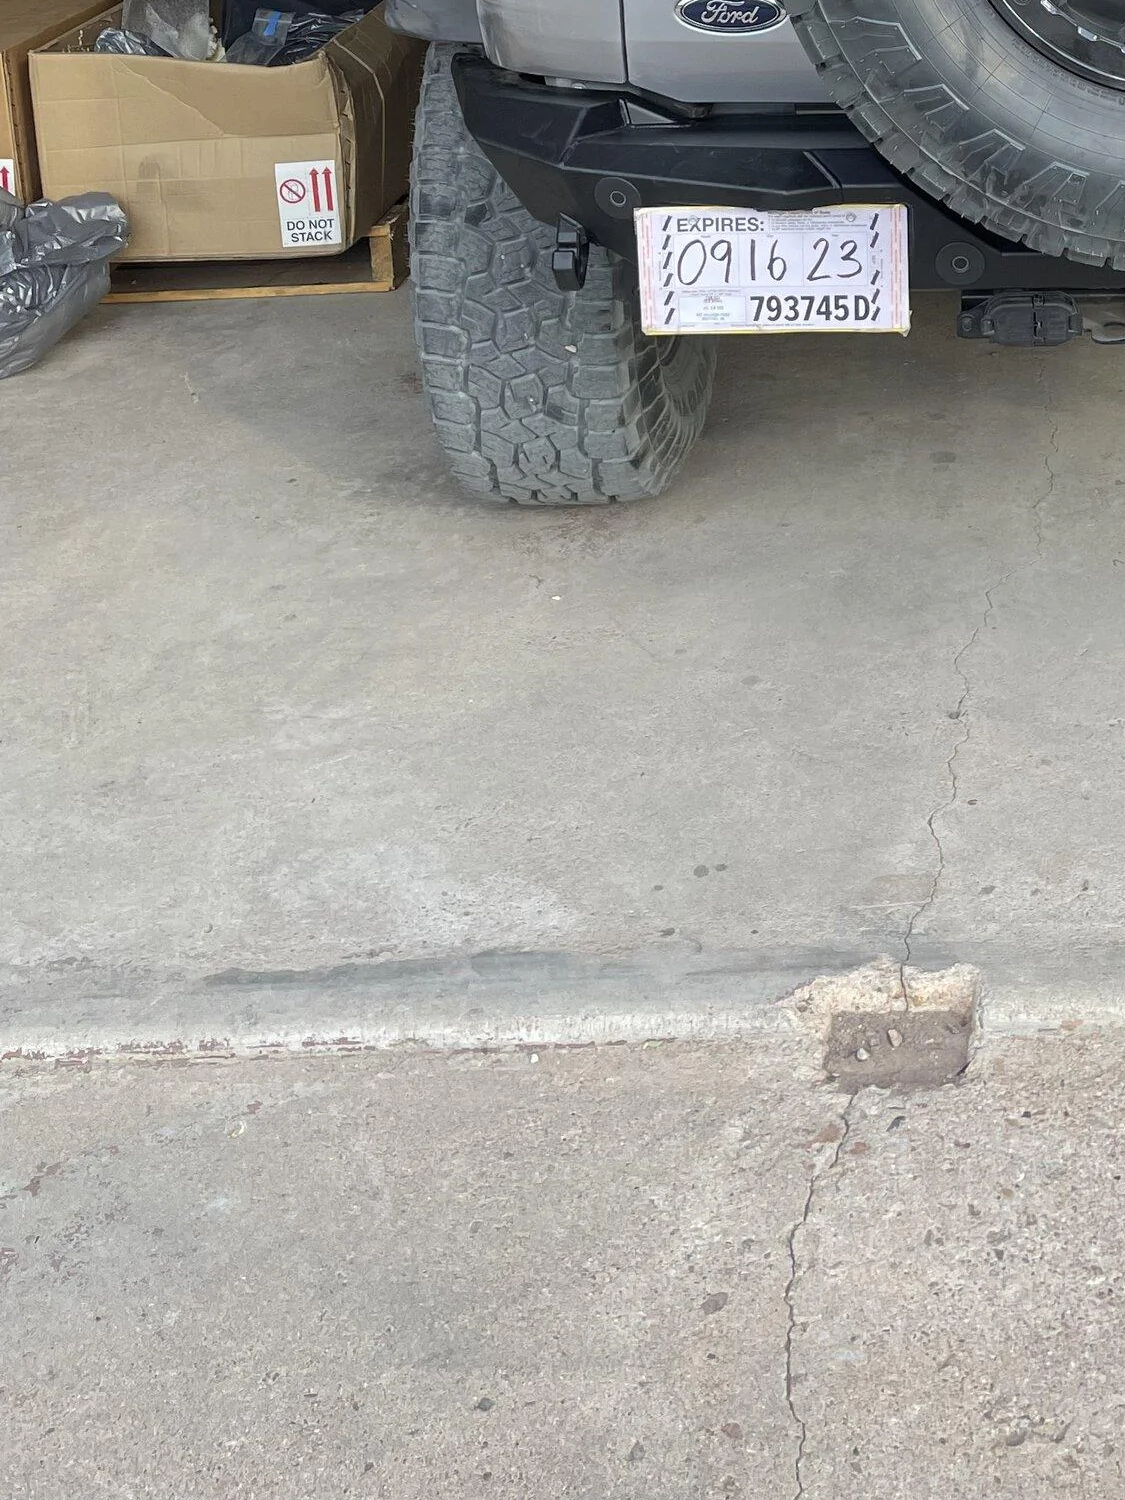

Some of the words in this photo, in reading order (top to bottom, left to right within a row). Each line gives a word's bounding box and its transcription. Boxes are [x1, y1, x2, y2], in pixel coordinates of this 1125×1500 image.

[701, 0, 760, 23] Ford
[286, 220, 305, 231] DO
[309, 218, 335, 230] NOT
[677, 216, 765, 233] EXPIRES:
[291, 231, 333, 243] STACK
[677, 238, 733, 286] 09
[749, 238, 787, 282] 16
[806, 237, 863, 282] 23
[750, 295, 871, 322] 793745D
